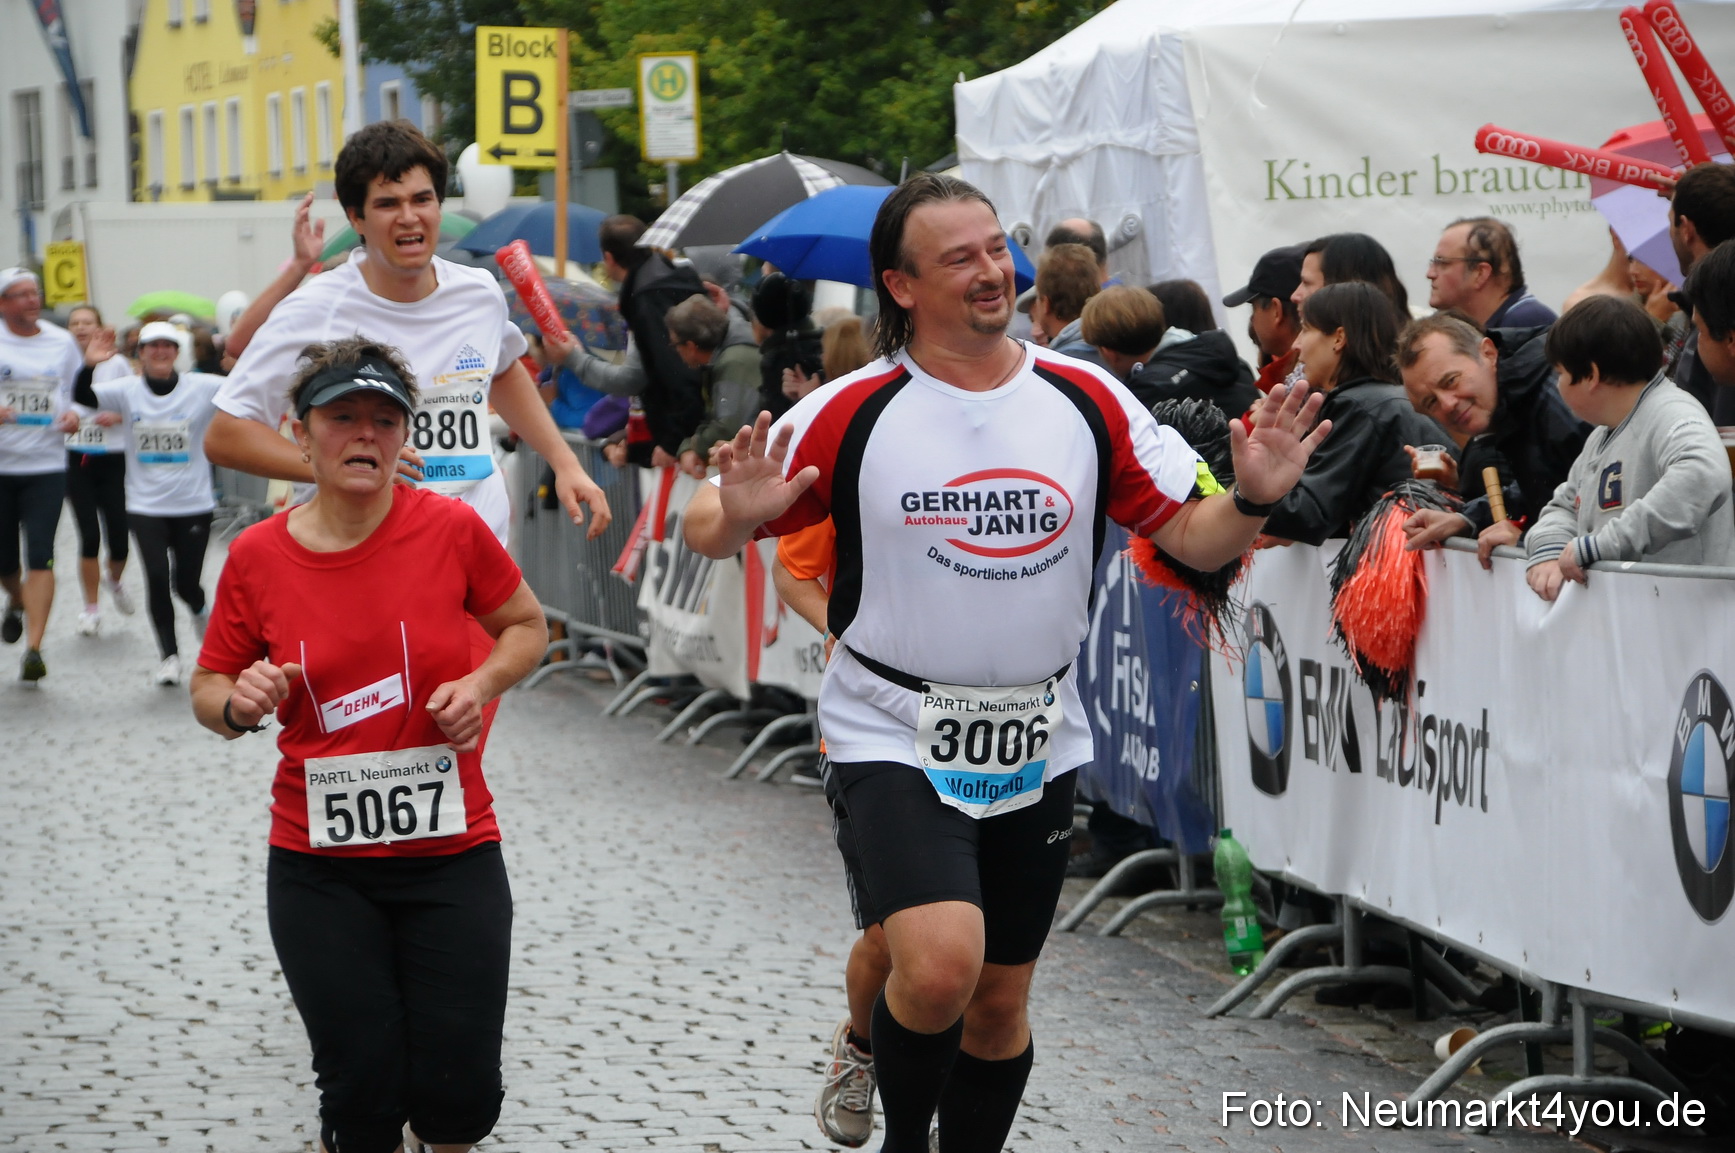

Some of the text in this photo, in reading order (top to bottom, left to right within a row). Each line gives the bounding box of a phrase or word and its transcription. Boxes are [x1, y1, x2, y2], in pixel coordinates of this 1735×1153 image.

[488, 33, 557, 58] Block
[503, 71, 544, 134] B
[1562, 150, 1611, 176] BKK
[1263, 155, 1418, 201] Kinder
[7, 392, 51, 412] 2134
[900, 488, 1056, 513] GERHART &
[904, 511, 1058, 536] Autohaus JÄNIG
[926, 544, 1070, 581] Das sportliche Autohaus
[344, 691, 380, 717] DEHN
[923, 695, 1041, 713] PARTL Neumarkt
[930, 714, 1049, 767] 3006
[309, 762, 430, 786] PARTL Neumarkt
[325, 780, 444, 843] 5067
